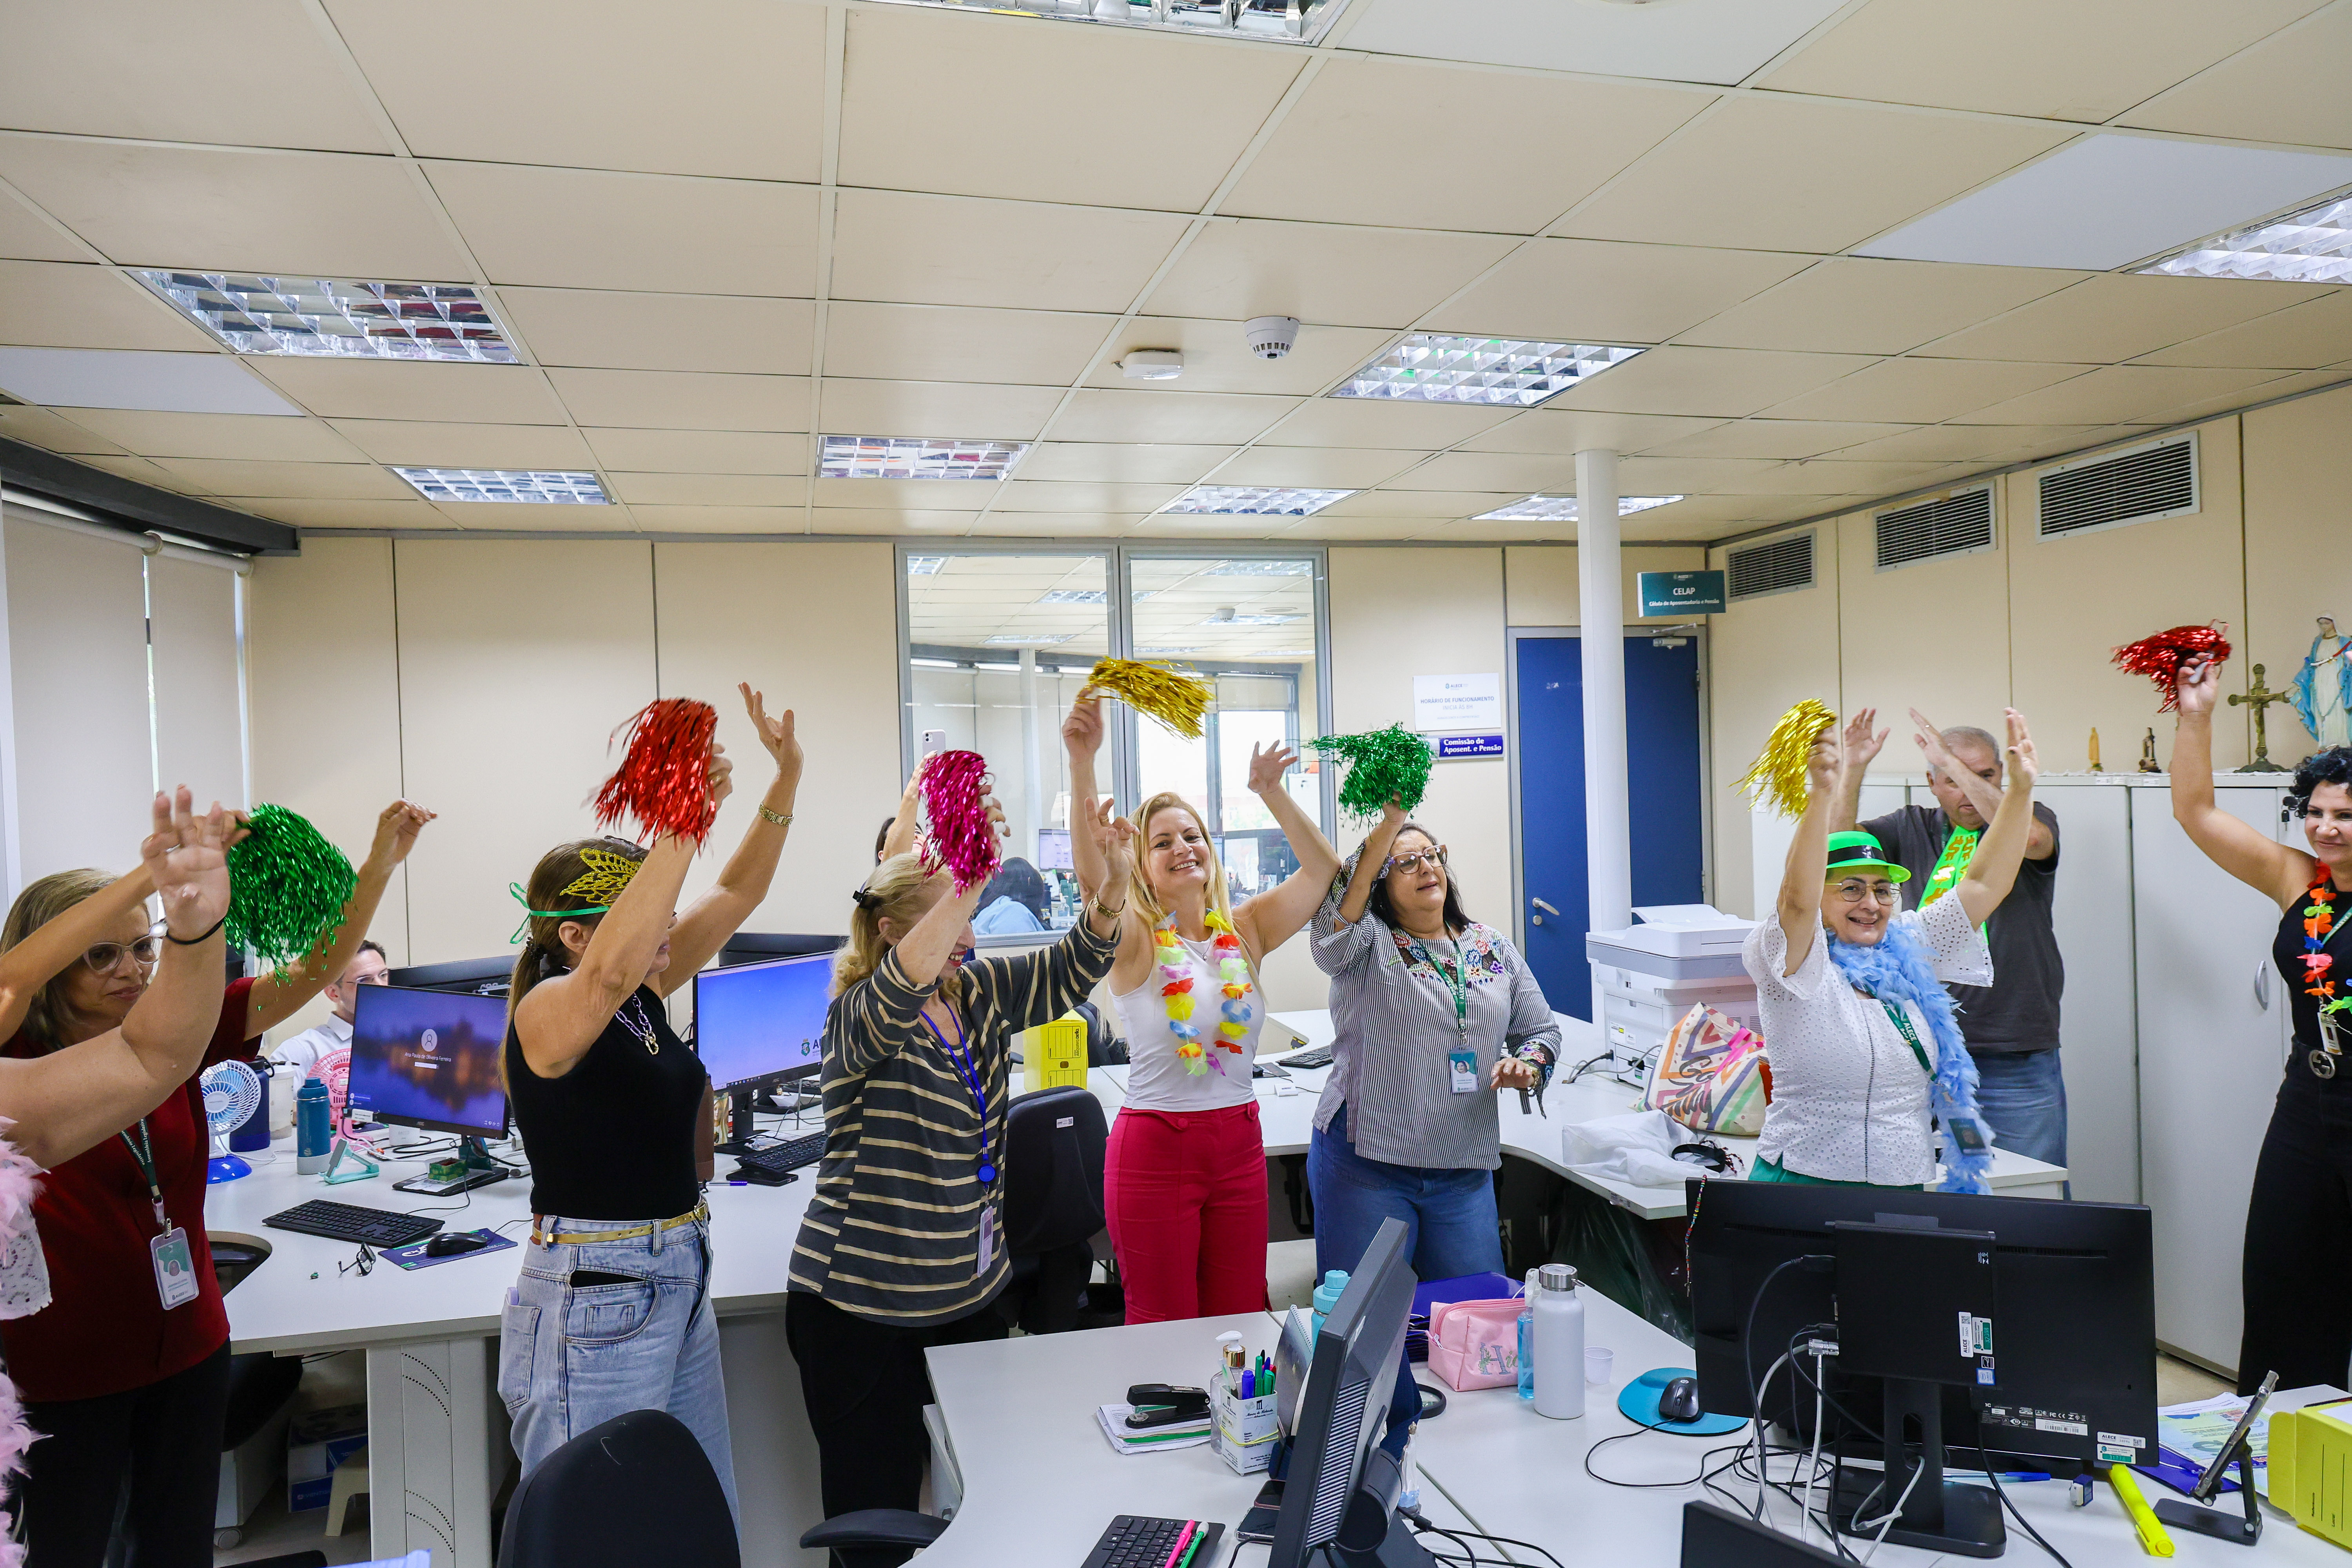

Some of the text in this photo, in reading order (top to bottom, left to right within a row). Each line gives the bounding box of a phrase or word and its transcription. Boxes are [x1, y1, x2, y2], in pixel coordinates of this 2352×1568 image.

[1443, 746, 1472, 755] Aposent.
[1903, 1023, 1917, 1041] ALECE
[143, 1140, 152, 1163] Assembleia
